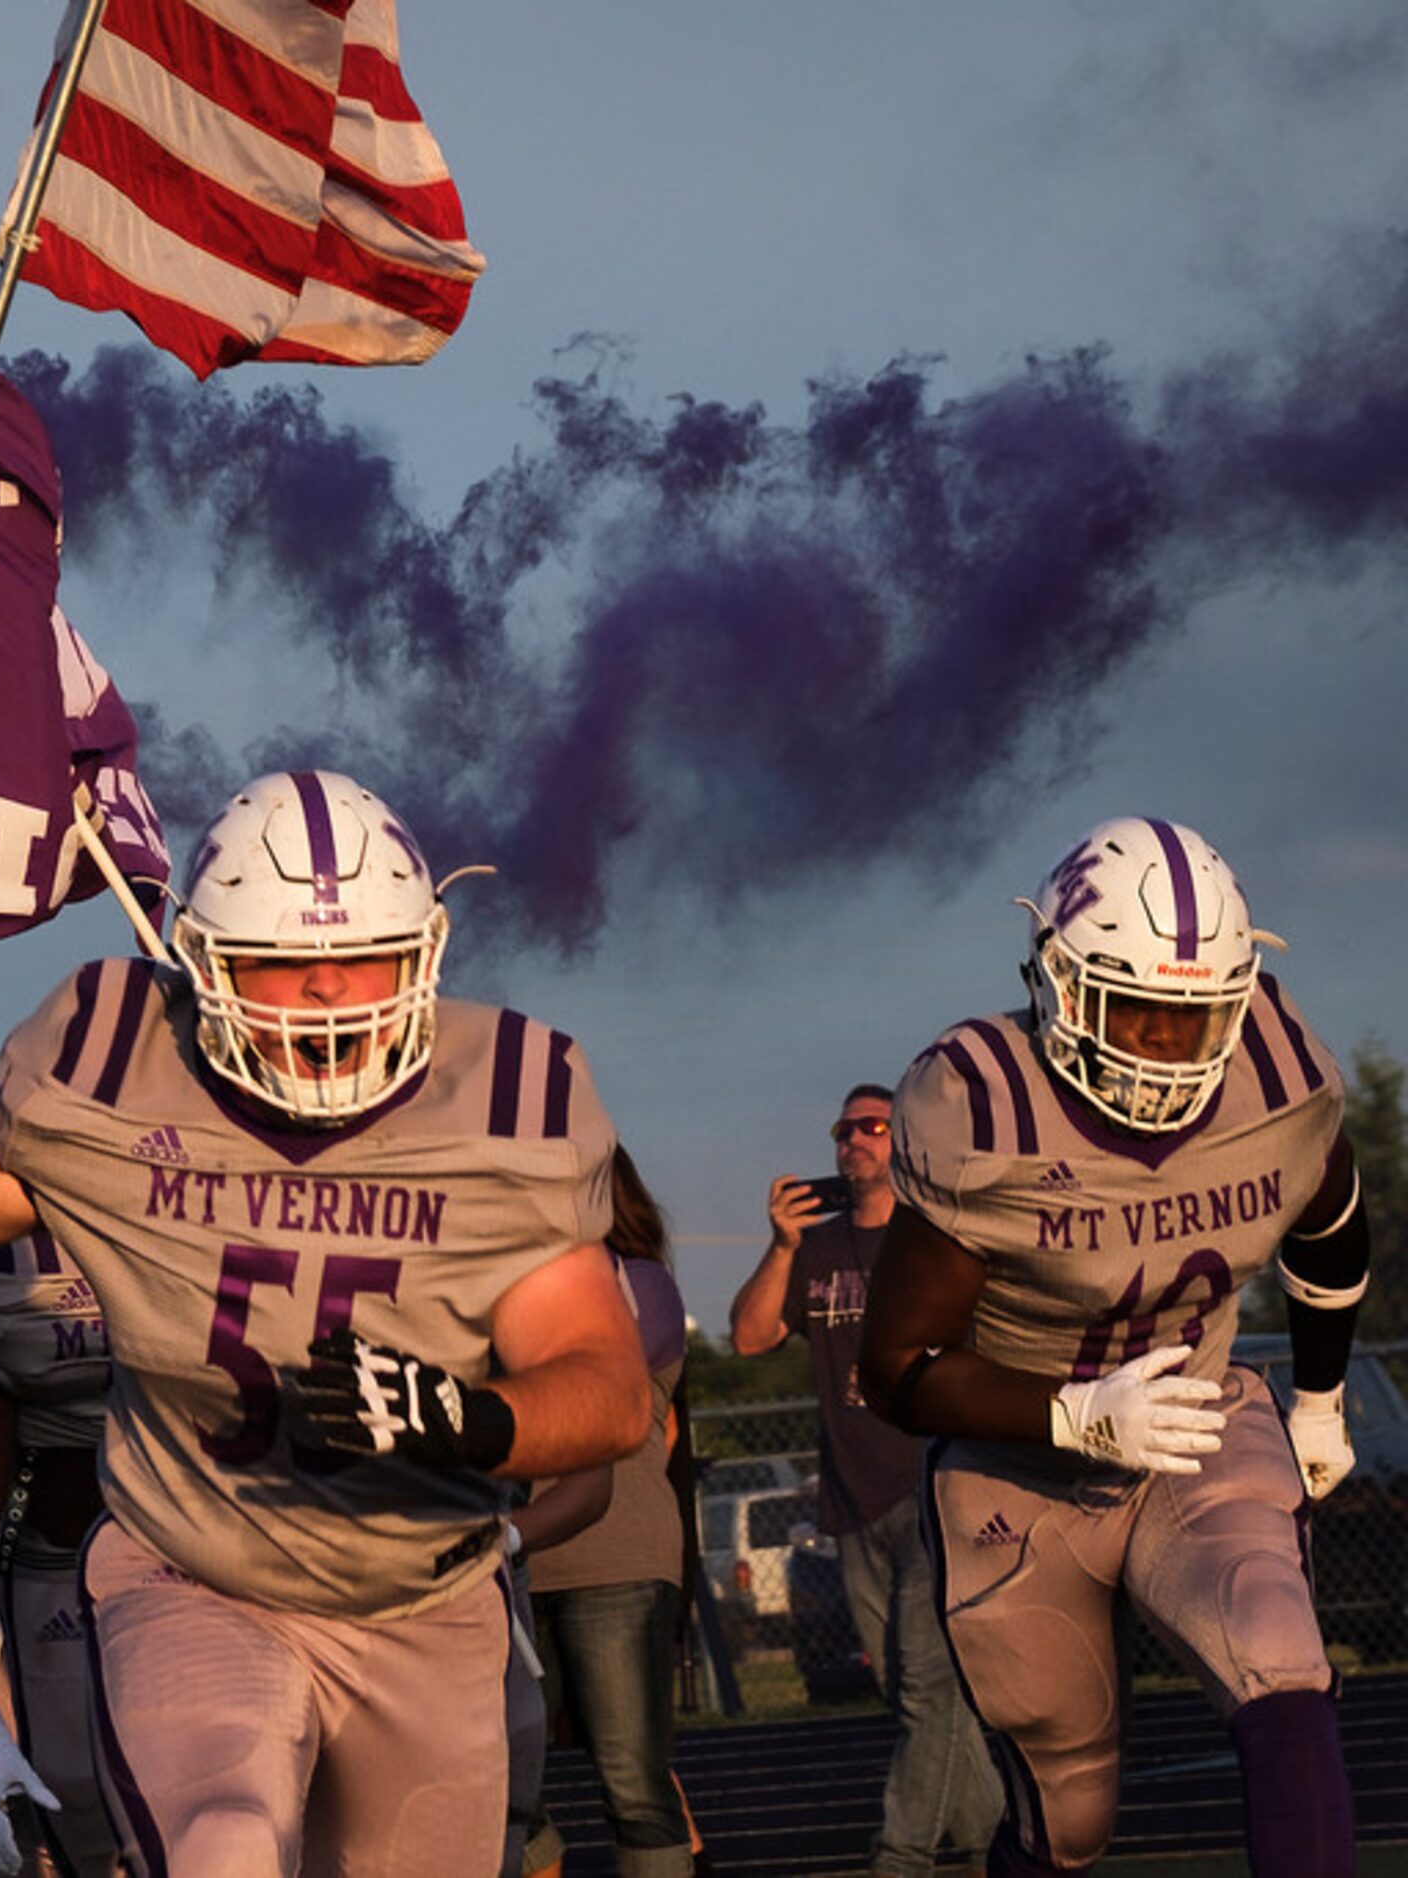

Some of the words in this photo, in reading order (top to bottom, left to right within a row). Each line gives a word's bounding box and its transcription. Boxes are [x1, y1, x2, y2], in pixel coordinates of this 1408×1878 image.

[300, 909, 349, 926] TIGERS
[1156, 963, 1212, 979] Riddell
[145, 1165, 226, 1225] MT
[243, 1174, 447, 1245] VERNON
[1037, 1207, 1105, 1251] MT
[1121, 1169, 1284, 1247] VERNON
